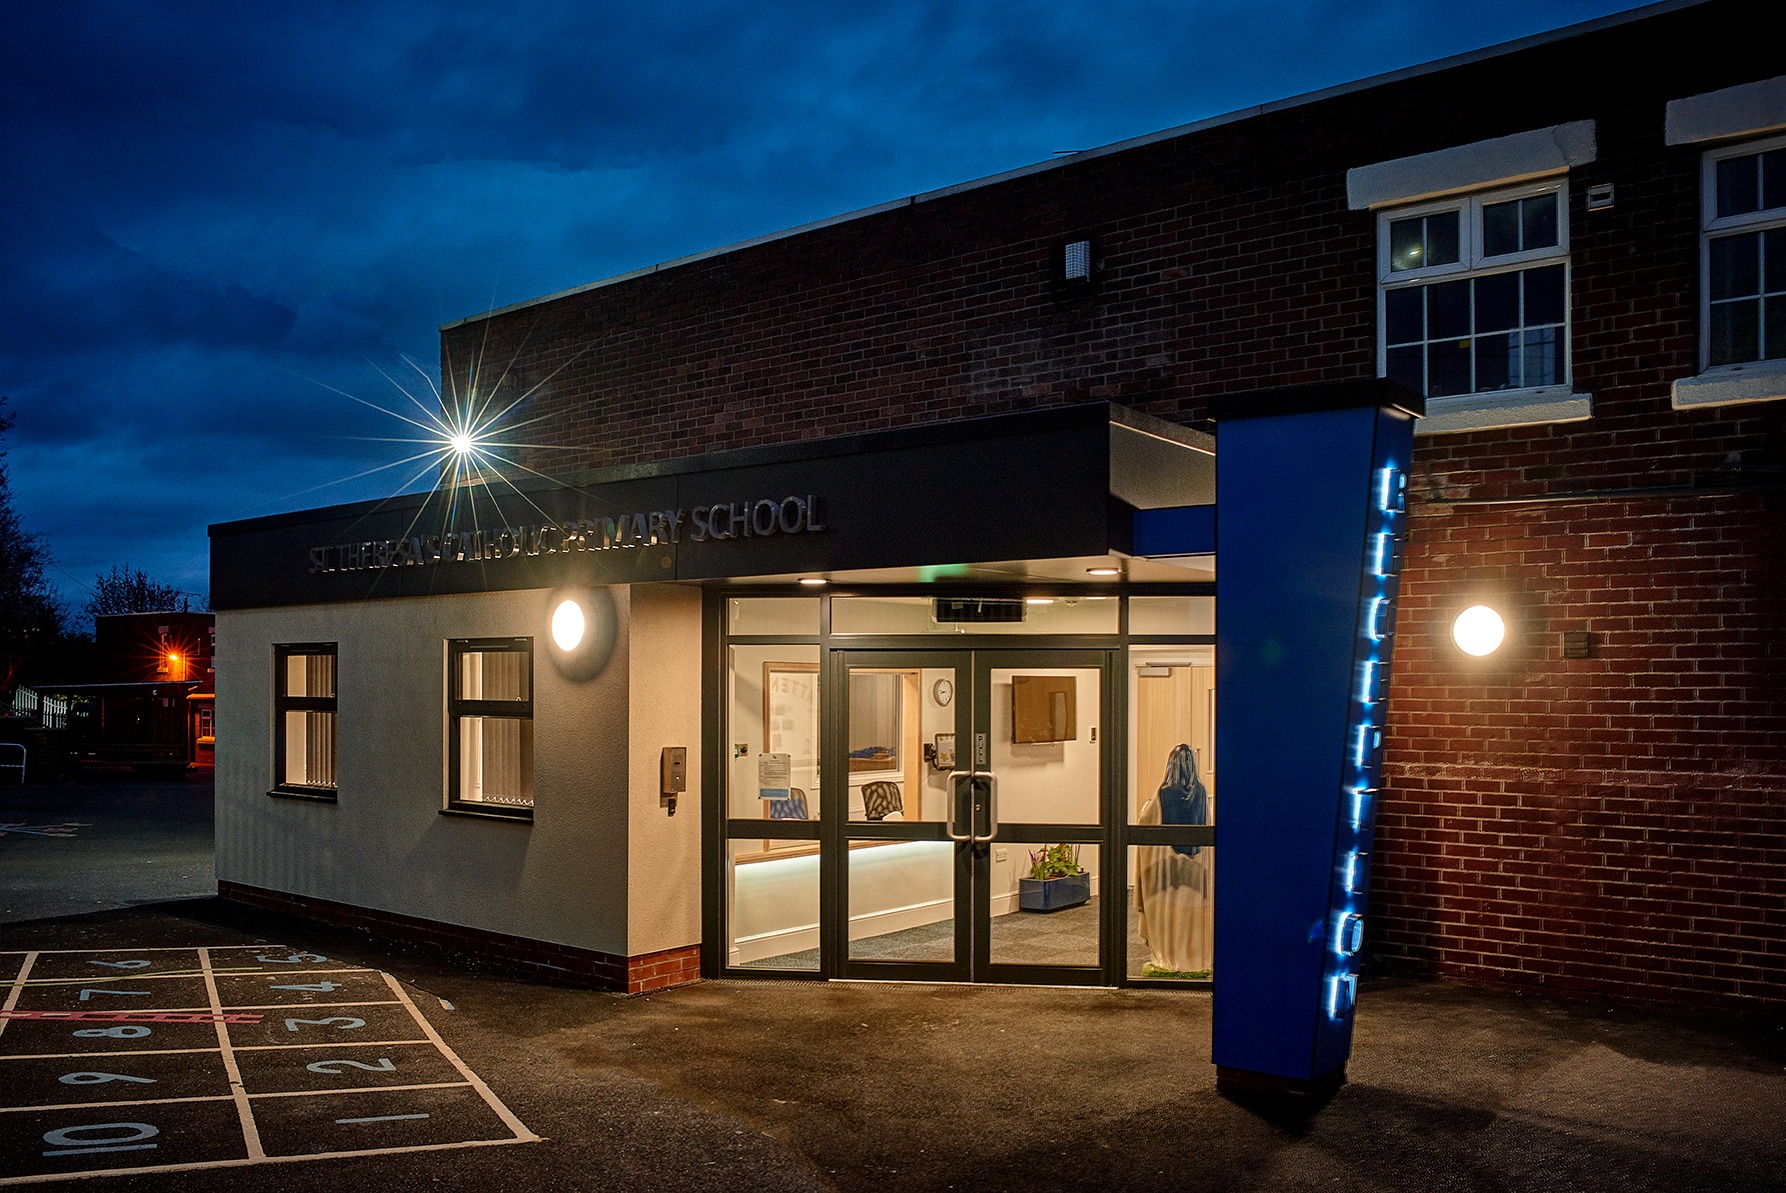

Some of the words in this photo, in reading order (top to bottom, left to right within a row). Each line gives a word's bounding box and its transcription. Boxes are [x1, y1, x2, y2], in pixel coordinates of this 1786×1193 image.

[561, 509, 685, 553] PRIMARY
[690, 494, 827, 542] SCHOOL
[256, 953, 327, 964] 5
[269, 981, 342, 992] 4
[79, 988, 151, 1001] 7
[284, 1016, 366, 1032] 3
[72, 1025, 152, 1038] 8
[305, 1057, 396, 1074] 2
[335, 1113, 430, 1125] 1
[42, 1121, 159, 1157] 10
